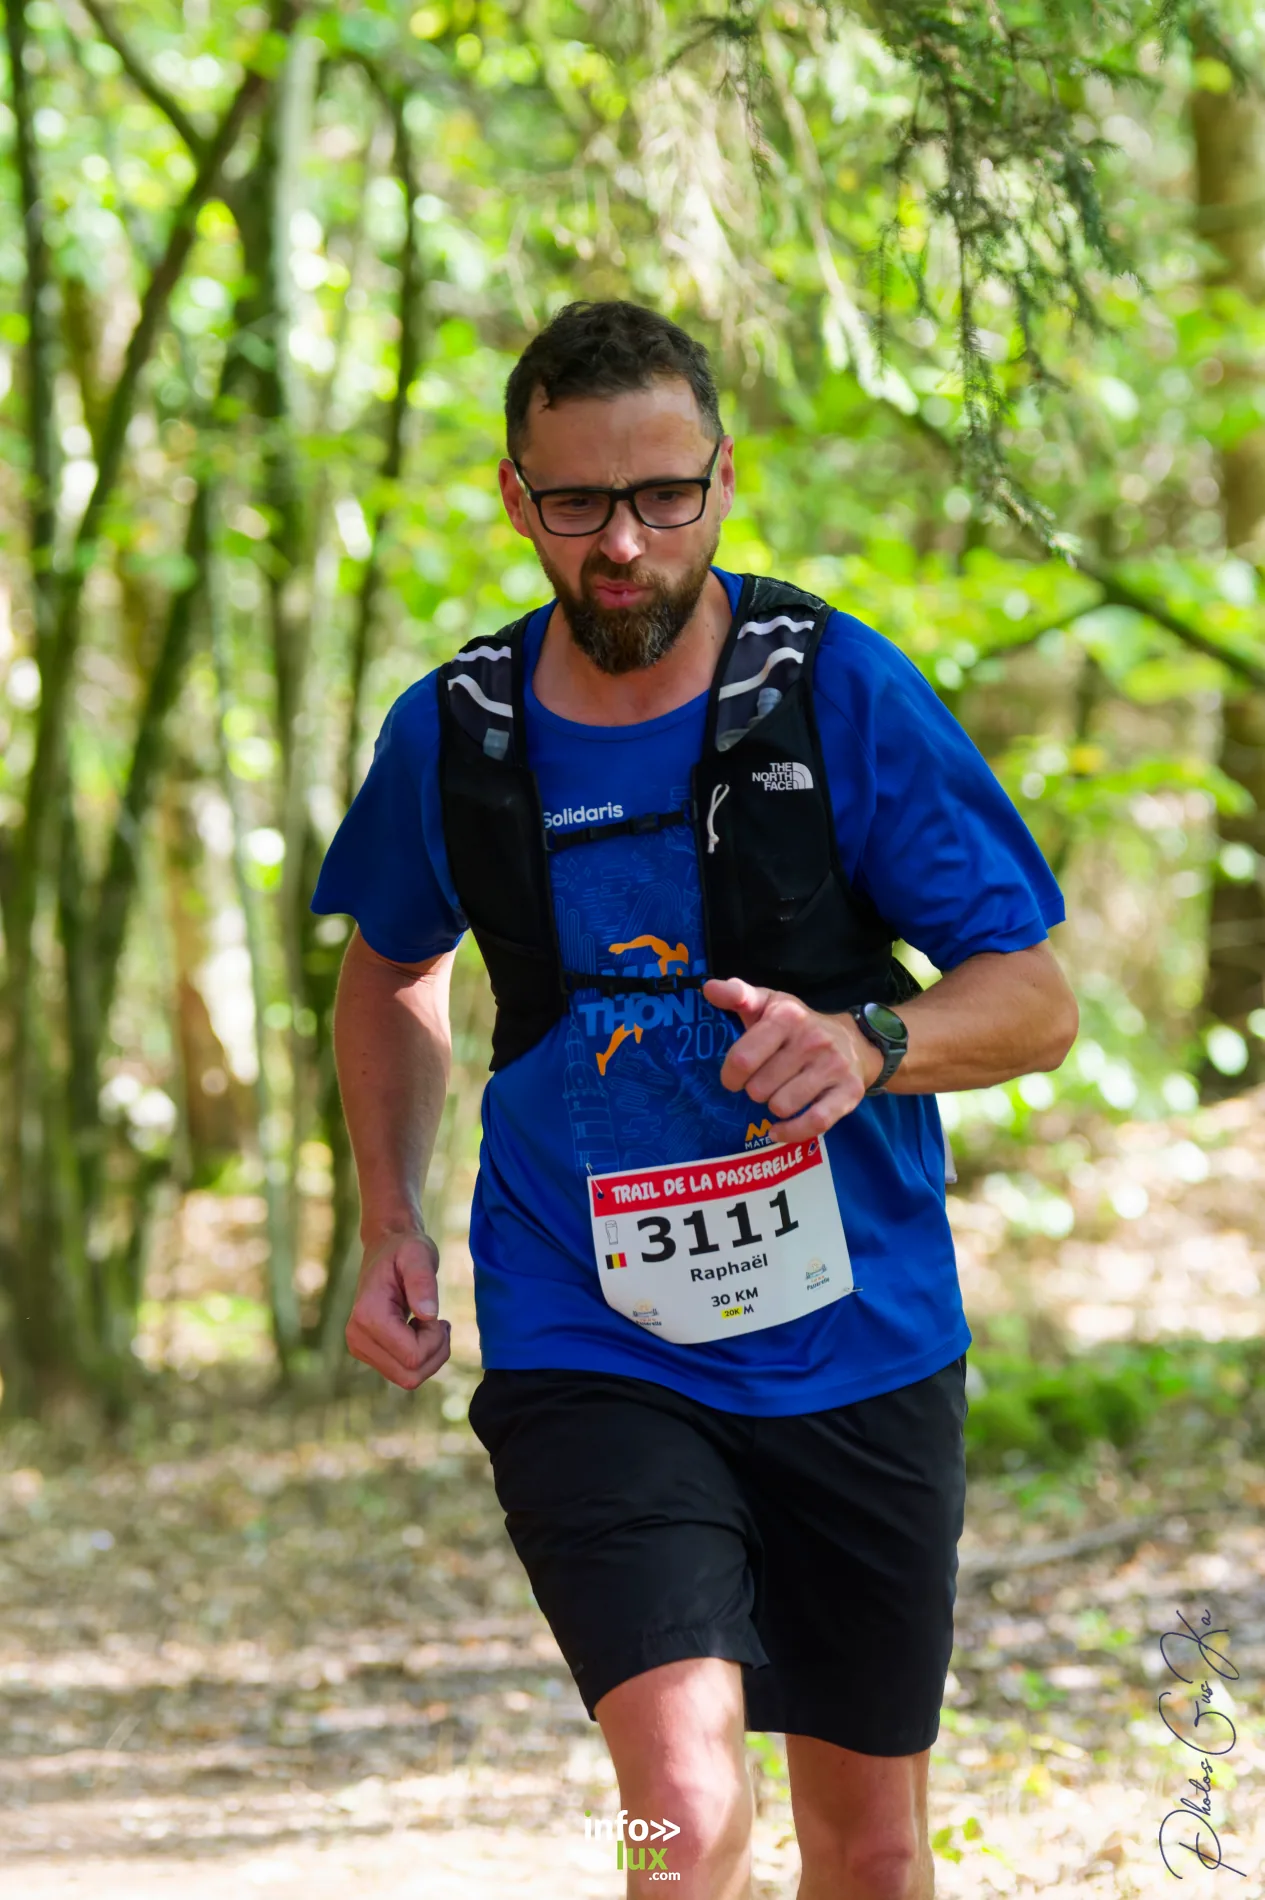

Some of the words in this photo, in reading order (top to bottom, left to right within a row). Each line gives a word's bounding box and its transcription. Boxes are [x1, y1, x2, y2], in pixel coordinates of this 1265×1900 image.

[751, 771, 793, 782] NORTH
[769, 762, 793, 772] THE
[764, 780, 793, 791] FACE
[543, 801, 624, 829] Solidaris
[676, 1021, 730, 1062] 202
[744, 1136, 772, 1150] MATE
[611, 1181, 661, 1204] TRAIL
[663, 1175, 687, 1197] DE
[689, 1170, 713, 1194] LA
[716, 1145, 804, 1187] PASSERELLE
[636, 1189, 800, 1263] 3111
[690, 1253, 769, 1282] Raphaël
[711, 1293, 731, 1308] 30
[735, 1286, 759, 1302] KM
